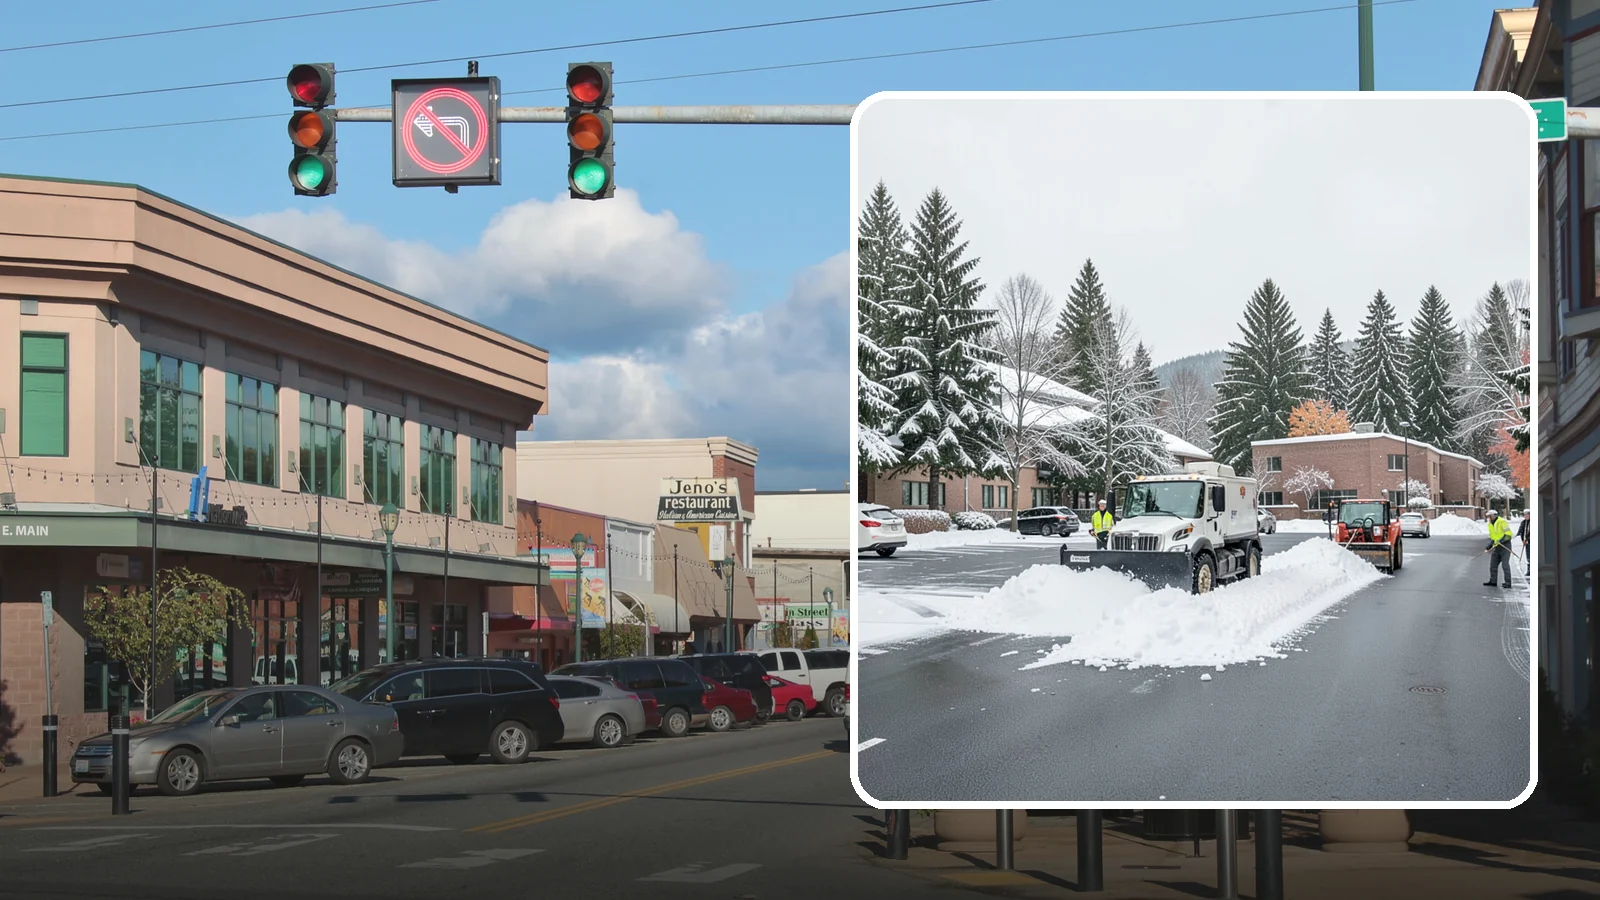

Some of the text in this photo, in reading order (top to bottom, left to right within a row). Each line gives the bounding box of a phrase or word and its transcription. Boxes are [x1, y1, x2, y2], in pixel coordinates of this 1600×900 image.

[670, 480, 727, 494] Jeno's
[665, 496, 731, 509] restaurant
[659, 510, 681, 519] Italian
[686, 510, 714, 519] American
[715, 510, 738, 519] Cuisine
[2, 525, 49, 536] E. MAIN
[786, 607, 795, 616] in
[797, 607, 829, 617] Street
[791, 619, 824, 627] lass
